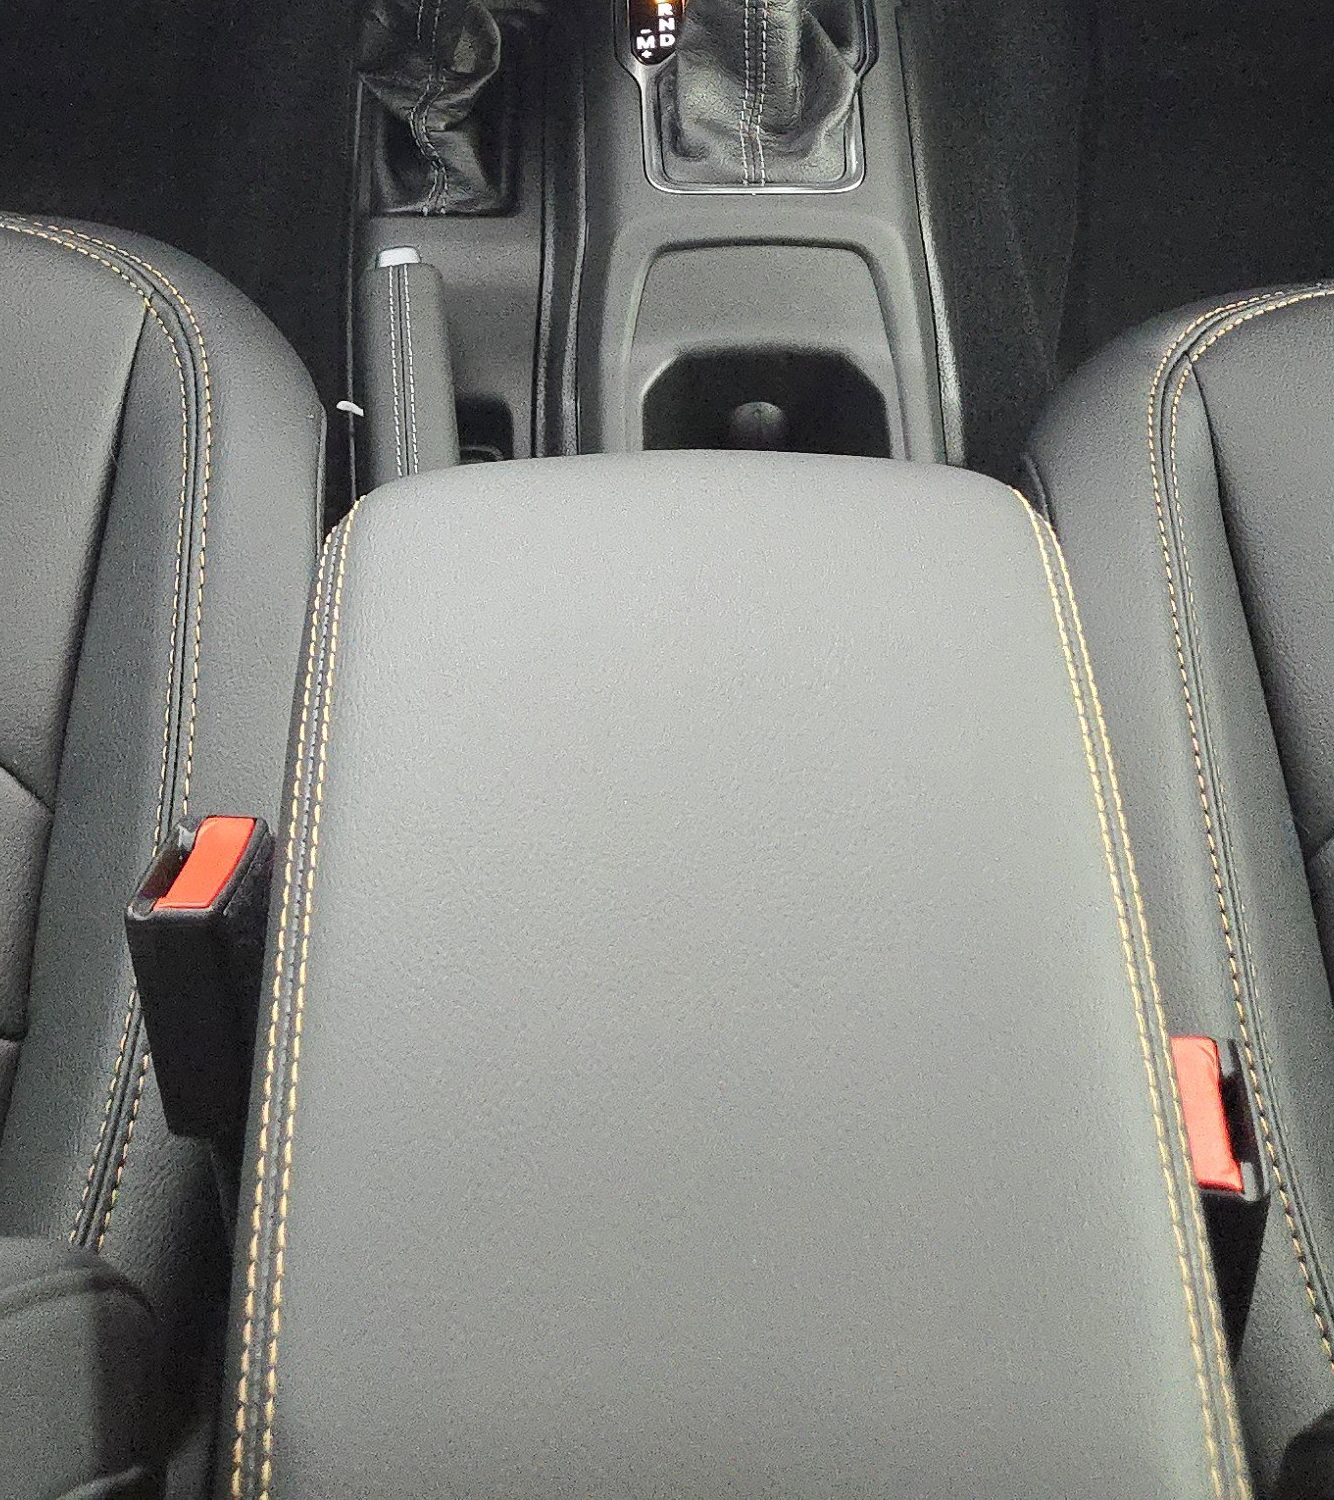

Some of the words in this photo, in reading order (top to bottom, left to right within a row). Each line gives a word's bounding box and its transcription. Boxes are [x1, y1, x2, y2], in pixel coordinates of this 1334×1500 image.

[658, 3, 674, 17] R
[659, 18, 675, 32] N
[636, 35, 655, 49] M
[660, 34, 676, 47] D
